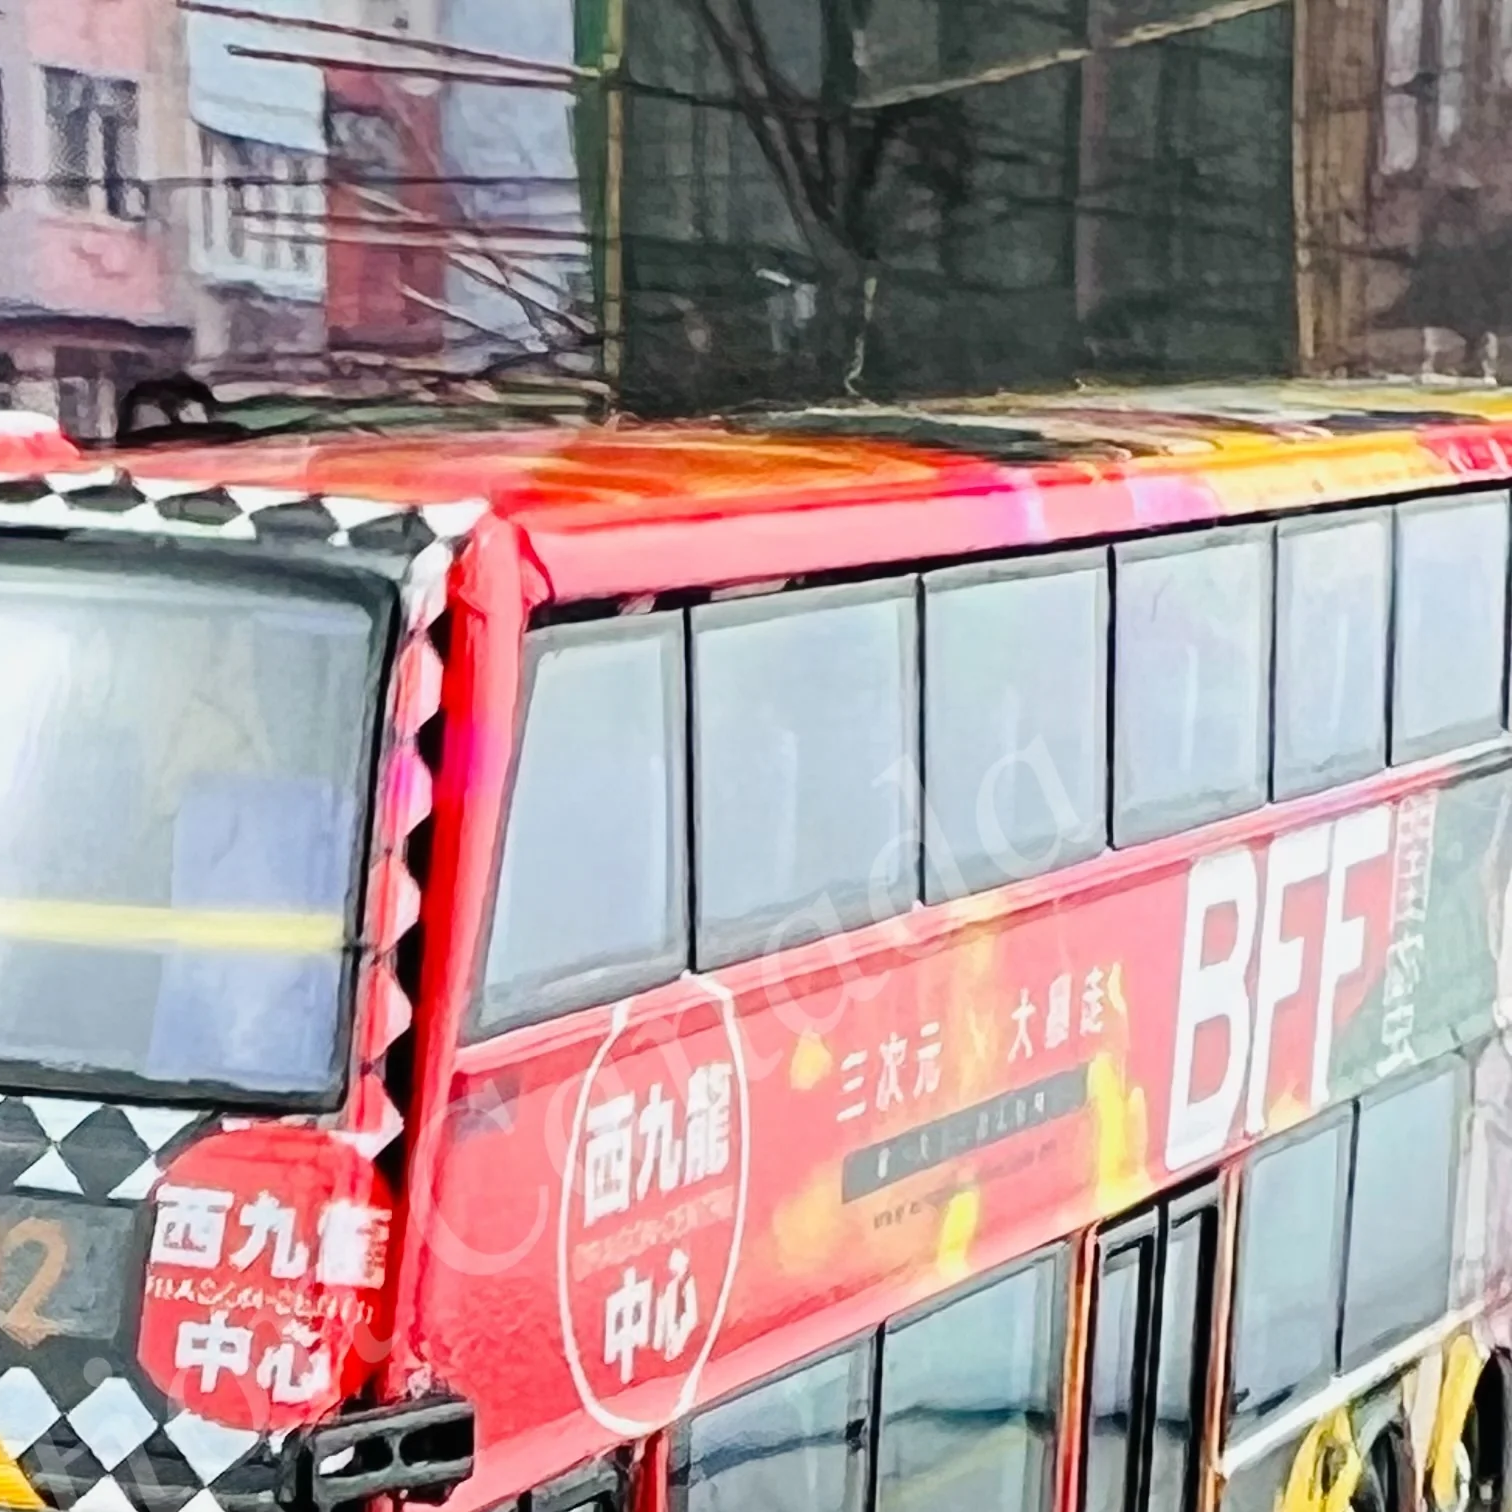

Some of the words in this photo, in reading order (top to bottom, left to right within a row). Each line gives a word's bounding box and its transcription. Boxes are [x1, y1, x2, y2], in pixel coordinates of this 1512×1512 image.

[1165, 805, 1391, 1171] BFF
[836, 1022, 942, 1122] 三次元
[583, 1061, 733, 1228] 西九龍
[150, 1183, 393, 1290] 西九龍
[175, 1309, 332, 1404] 中心
[604, 1247, 699, 1385] 中心
